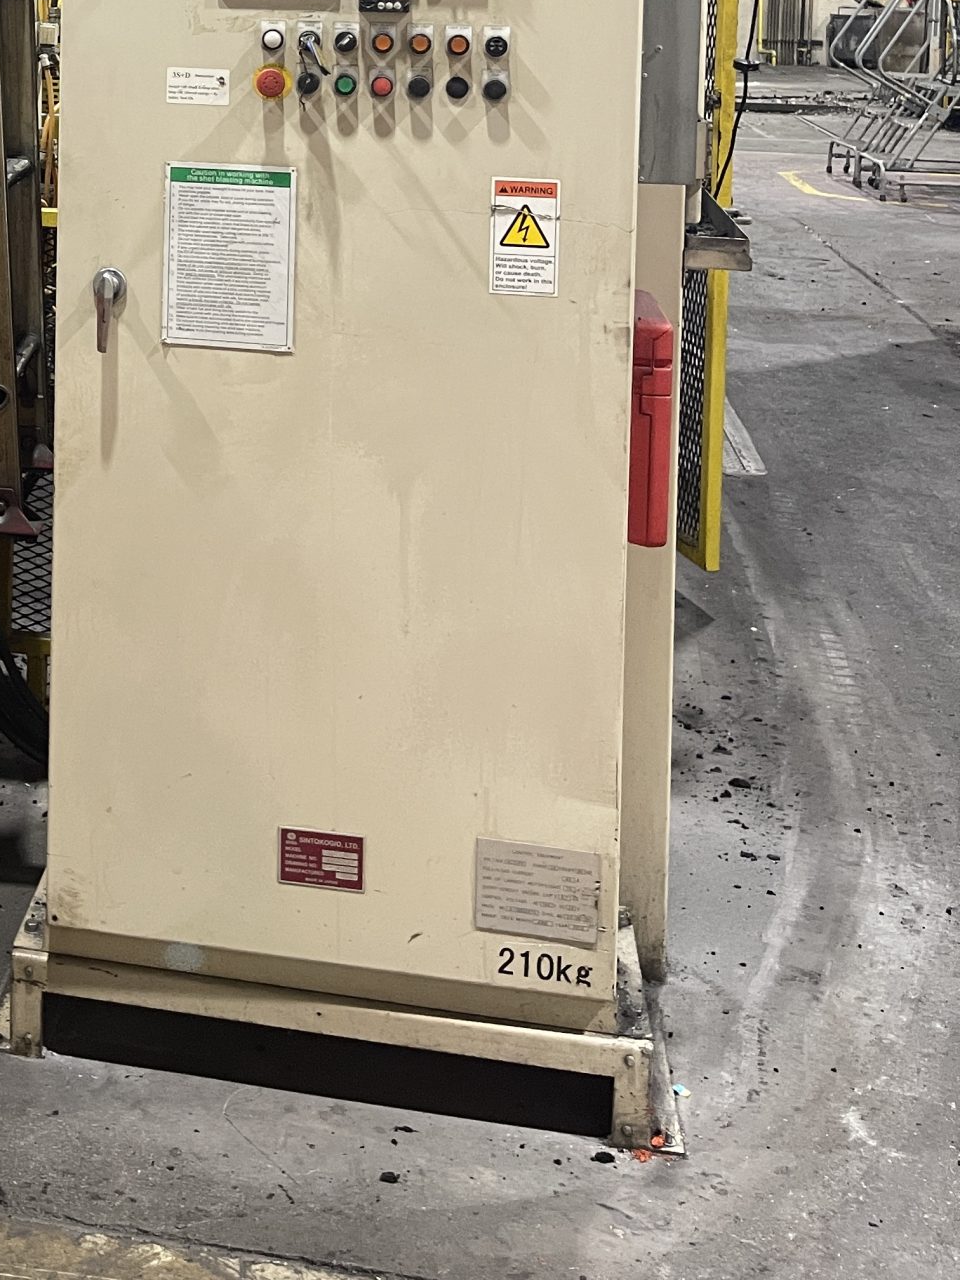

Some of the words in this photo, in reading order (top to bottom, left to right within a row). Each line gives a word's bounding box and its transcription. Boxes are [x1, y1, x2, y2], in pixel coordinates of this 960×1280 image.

[190, 168, 218, 176] Caution
[226, 170, 254, 179] working
[215, 176, 243, 184] blasting
[509, 185, 553, 195] WARNING
[497, 947, 593, 988] 210kg
